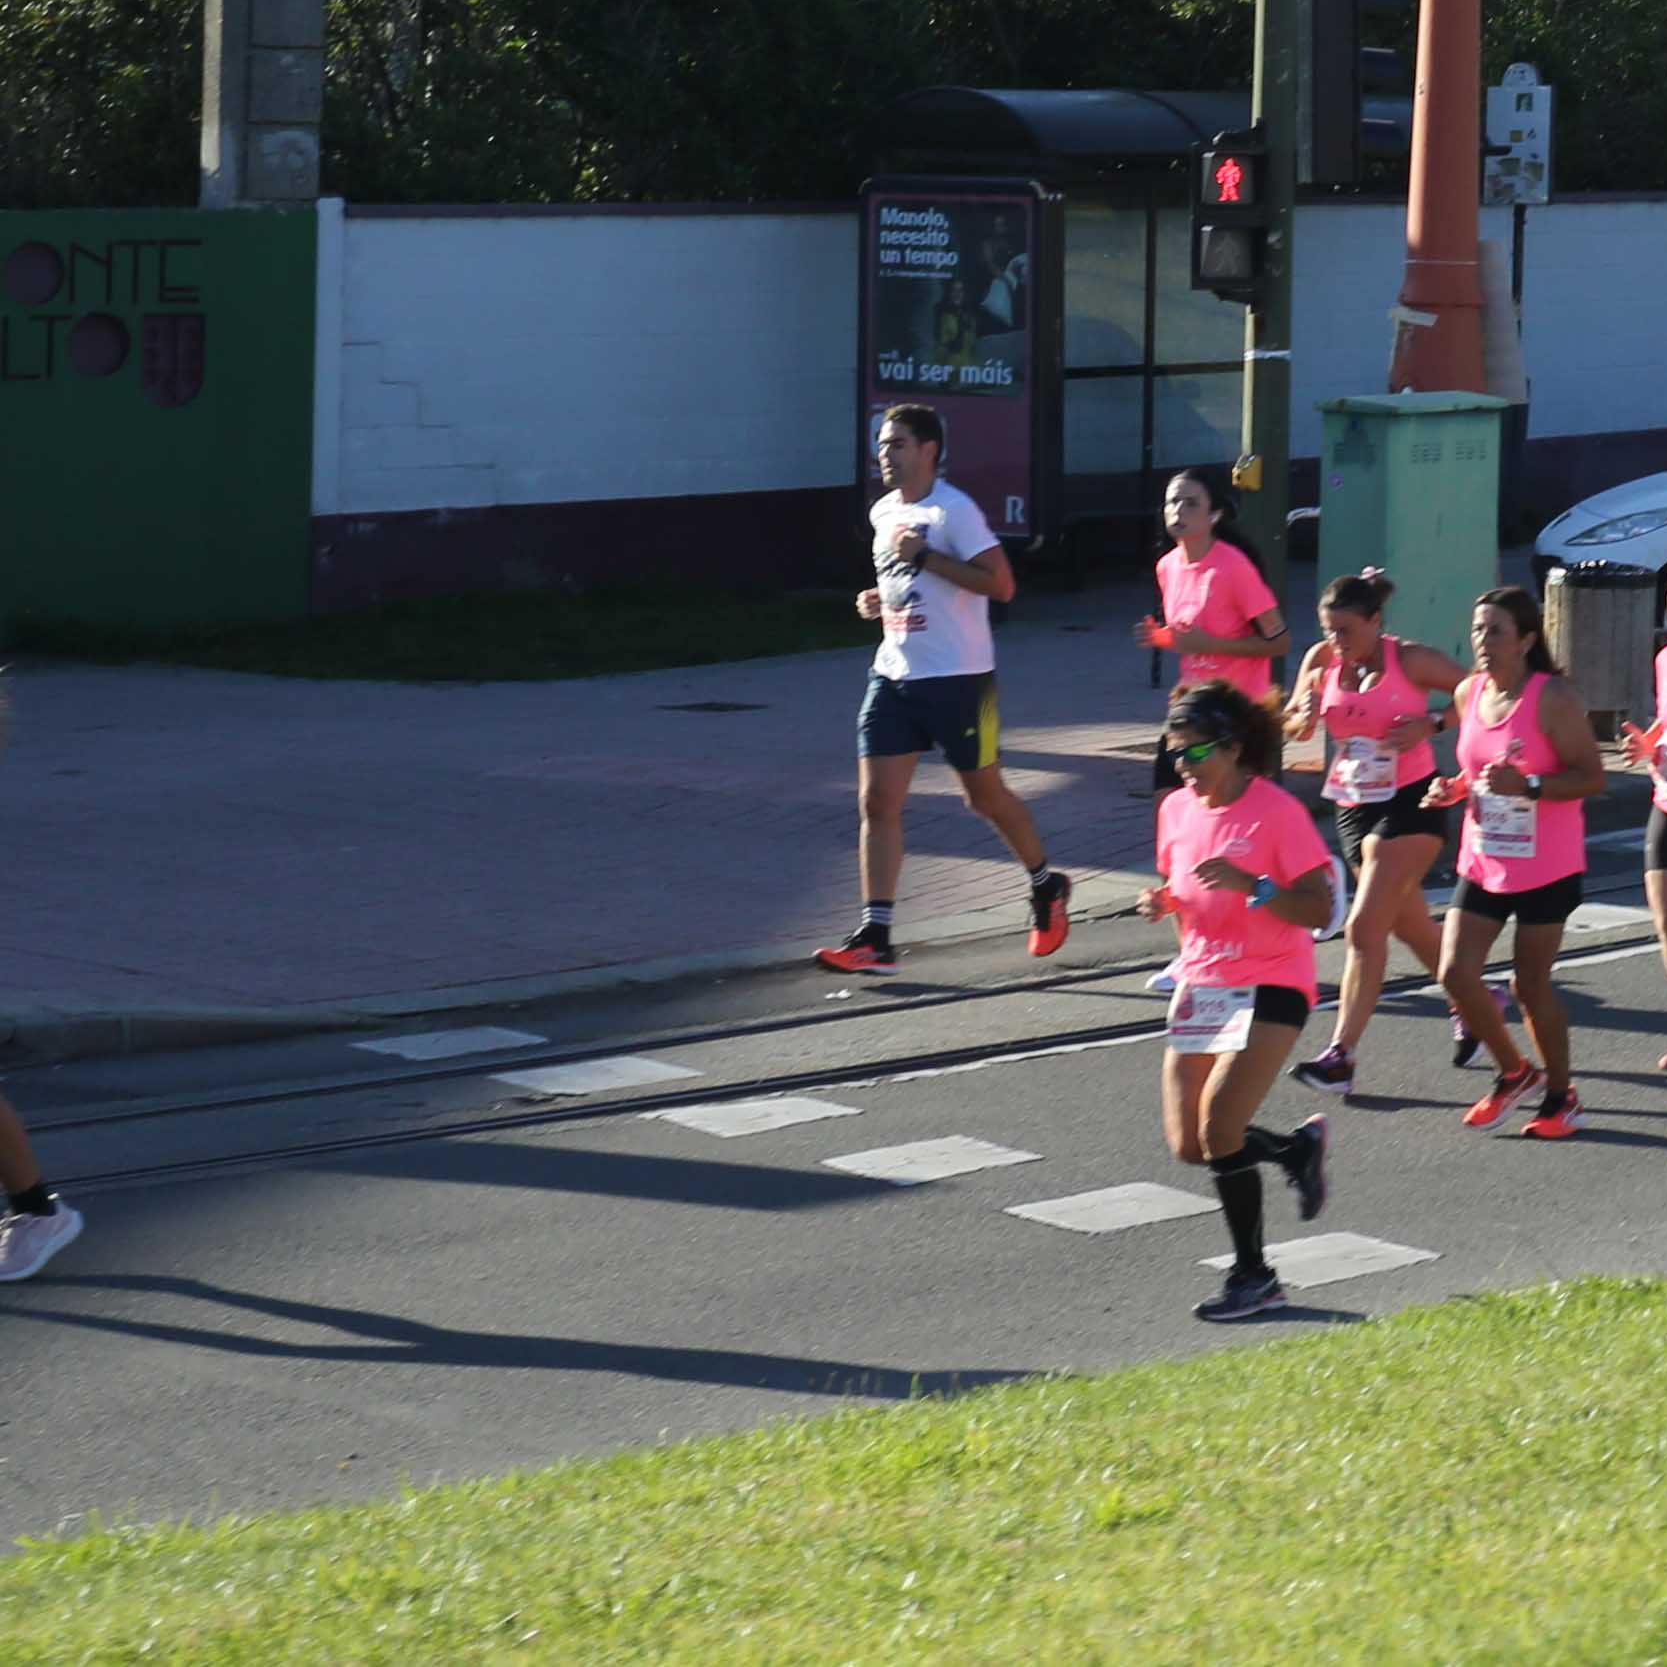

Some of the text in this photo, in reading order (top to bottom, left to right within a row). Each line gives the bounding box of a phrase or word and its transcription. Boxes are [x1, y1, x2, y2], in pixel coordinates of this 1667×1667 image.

[879, 206, 950, 229] Manolo,
[879, 229, 949, 246] necesito
[879, 247, 959, 269] un tempo
[878, 356, 1014, 385] vai ser máis
[1004, 495, 1025, 524] R
